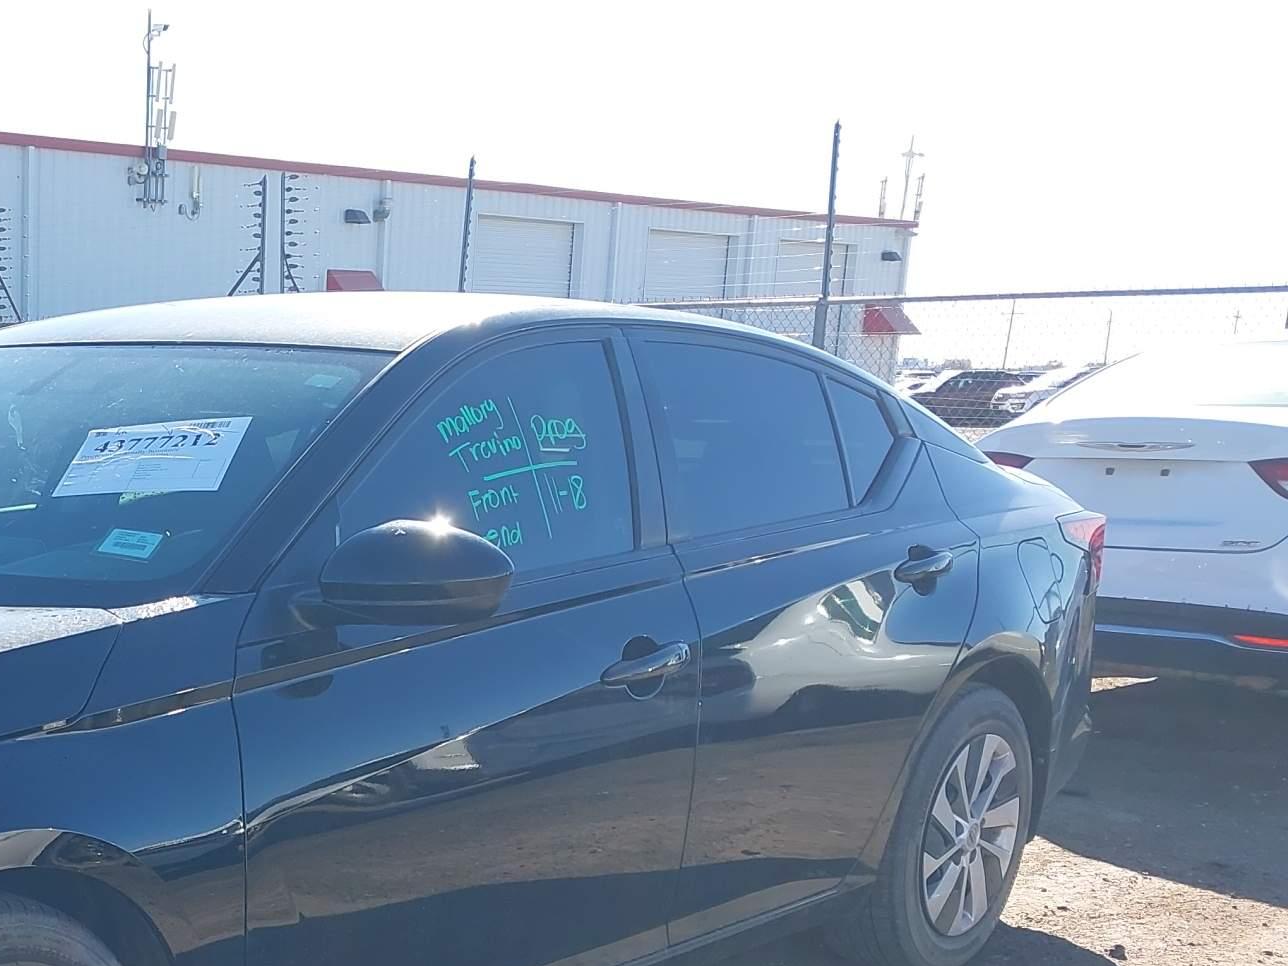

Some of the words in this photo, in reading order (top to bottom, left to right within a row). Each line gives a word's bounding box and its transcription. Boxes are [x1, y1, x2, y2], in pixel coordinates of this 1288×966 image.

[94, 432, 221, 453] 43777212
[467, 484, 520, 521] Front
[484, 521, 523, 548] end
